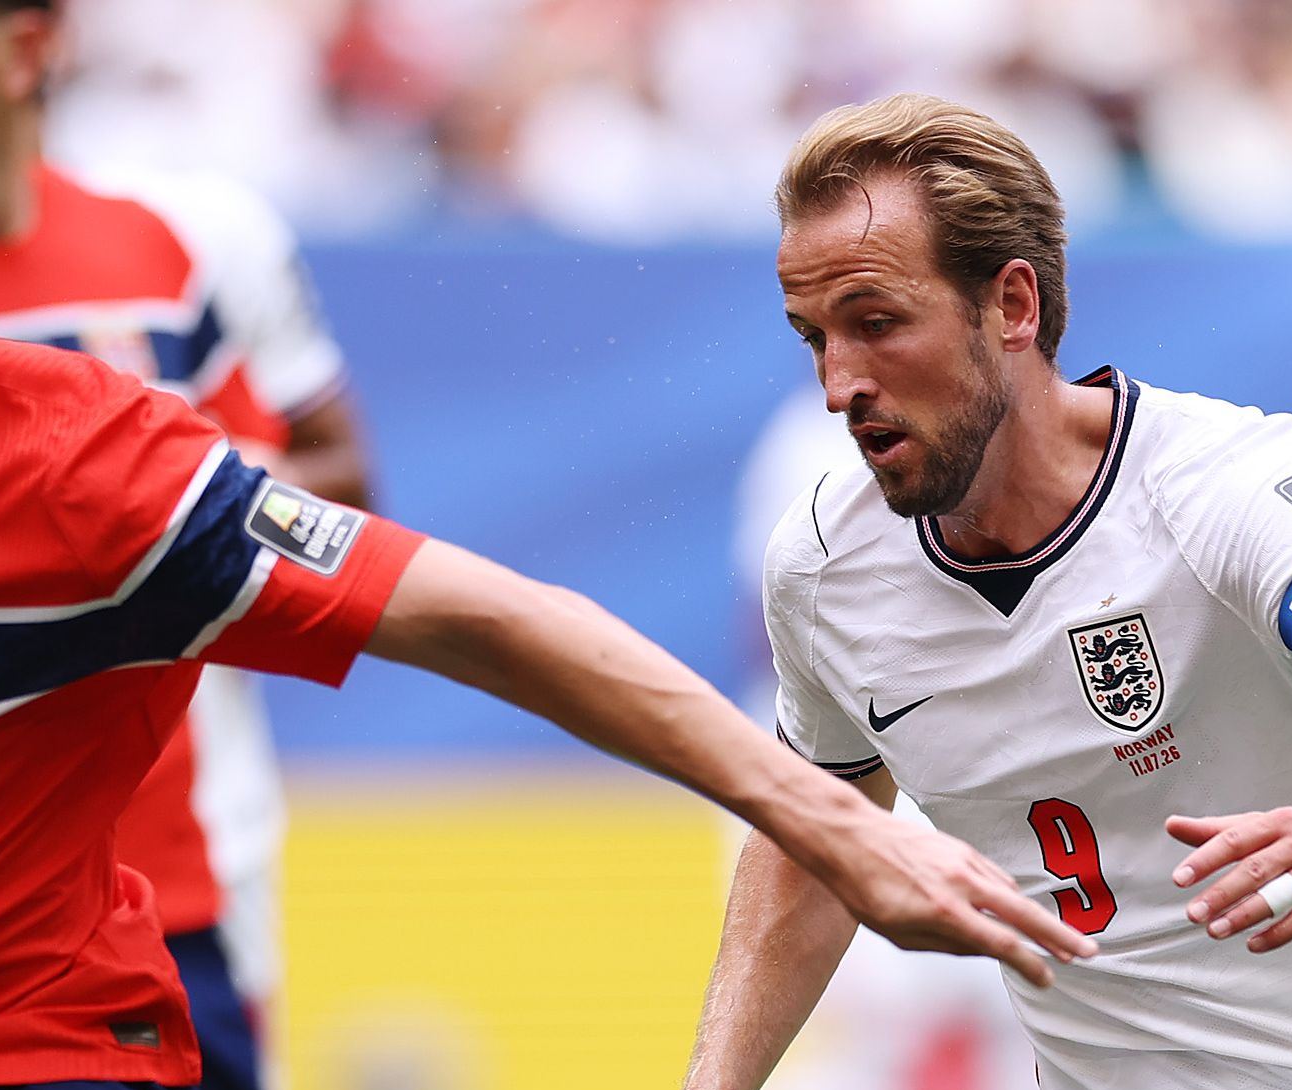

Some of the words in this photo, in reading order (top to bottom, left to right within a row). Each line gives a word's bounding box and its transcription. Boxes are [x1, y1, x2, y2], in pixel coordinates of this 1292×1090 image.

[1113, 723, 1174, 761] NORWAY
[1129, 745, 1181, 776] 11.07.26
[1027, 798, 1117, 935] 9
